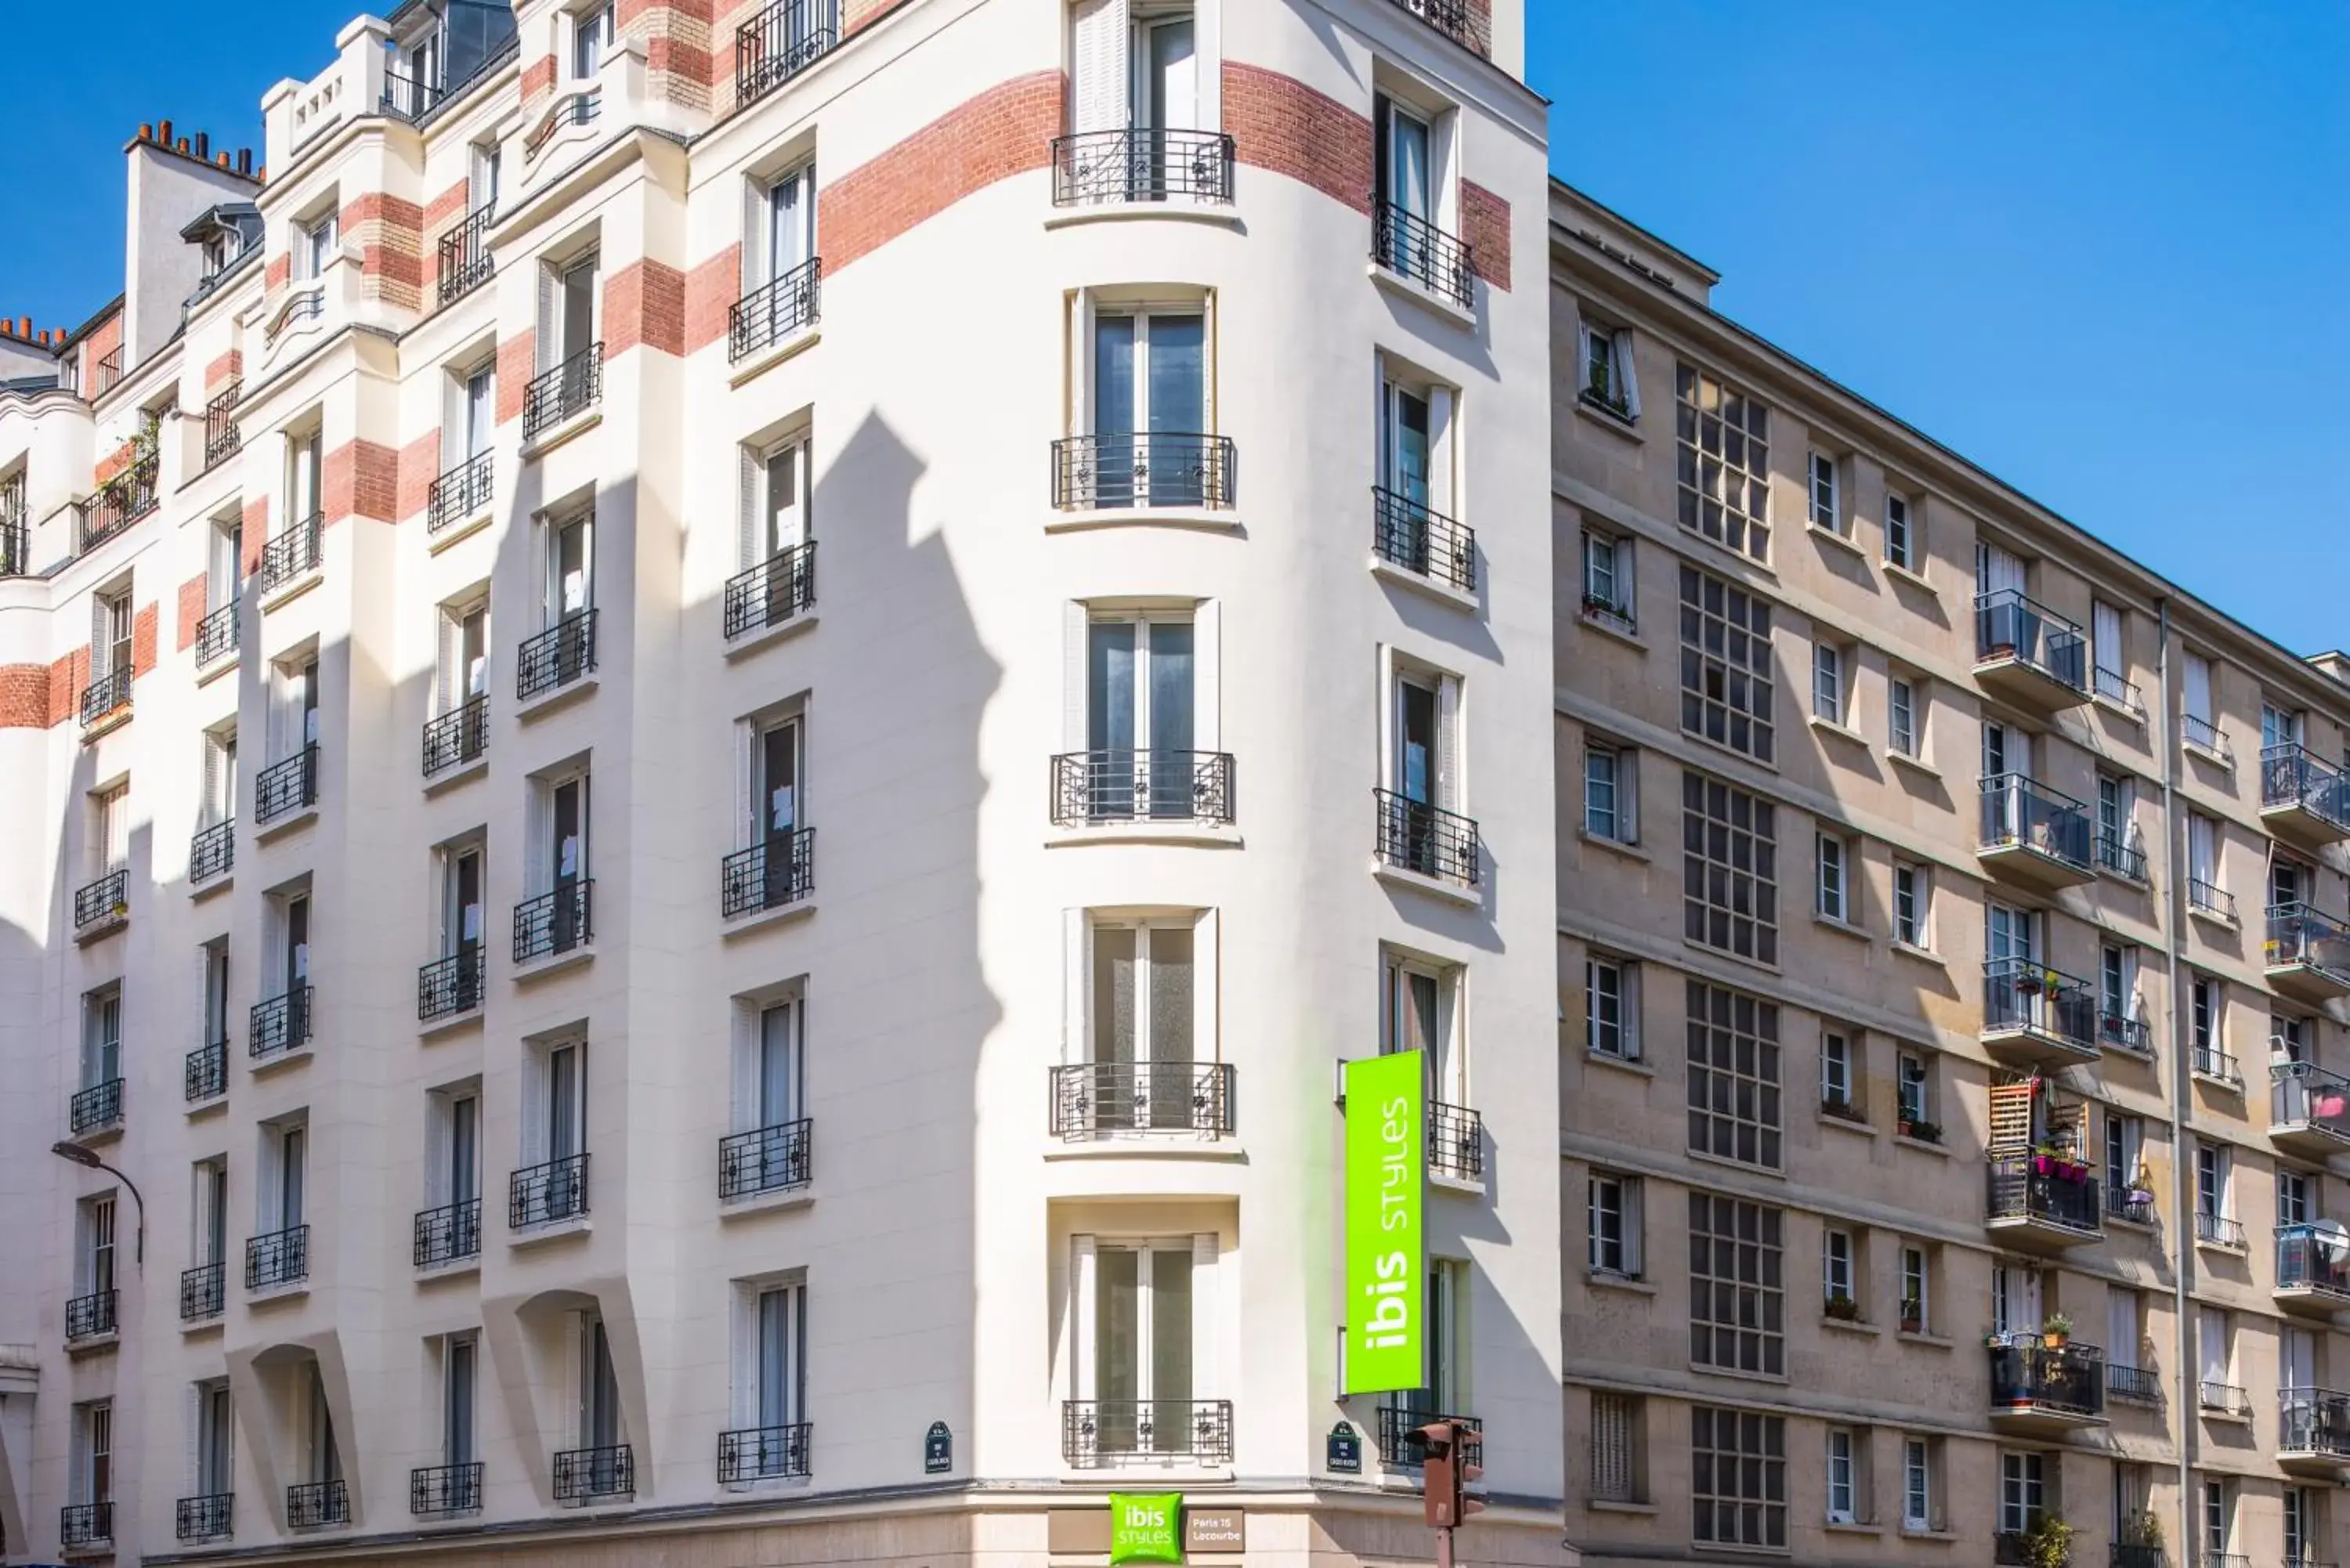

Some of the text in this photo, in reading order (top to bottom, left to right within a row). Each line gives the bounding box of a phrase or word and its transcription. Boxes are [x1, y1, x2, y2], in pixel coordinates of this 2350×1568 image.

[1365, 1251, 1408, 1349] ibis
[1126, 1505, 1165, 1527] ibis
[1192, 1518, 1218, 1528] Paris
[1192, 1530, 1242, 1541] Lecourbe
